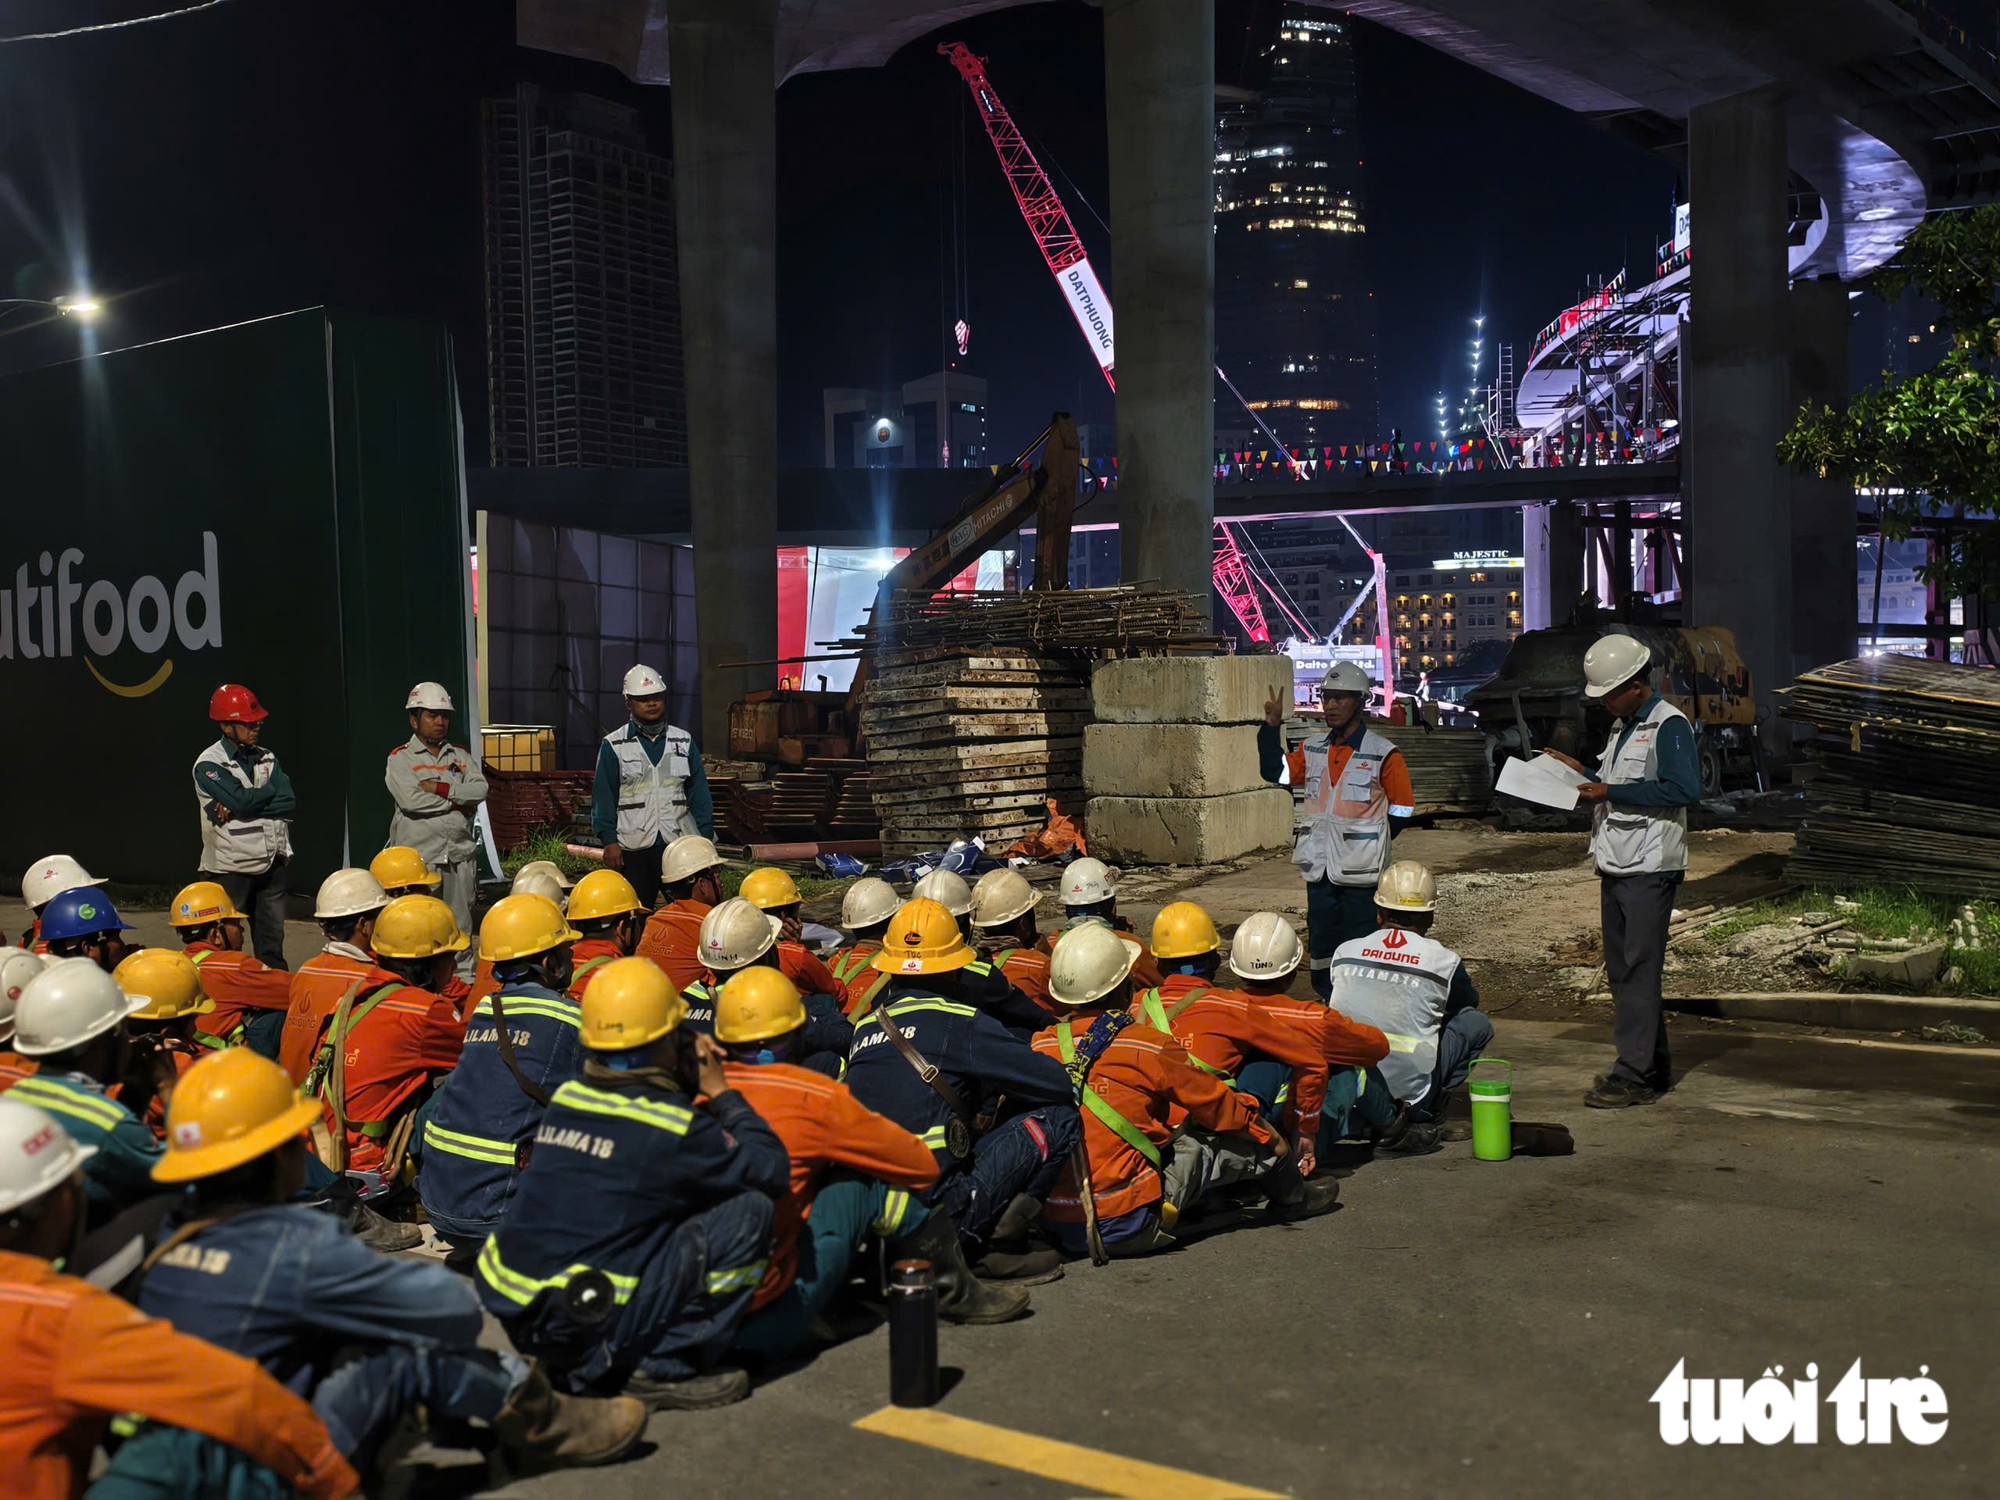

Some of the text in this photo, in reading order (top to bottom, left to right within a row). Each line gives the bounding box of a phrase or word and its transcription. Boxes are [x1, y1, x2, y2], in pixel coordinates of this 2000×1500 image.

[973, 501, 1005, 533] HITACHI
[1453, 550, 1509, 559] MAJESTIC
[1296, 660, 1328, 670] Daito
[463, 1028, 532, 1047] LILAM 18
[591, 1136, 615, 1159] 18
